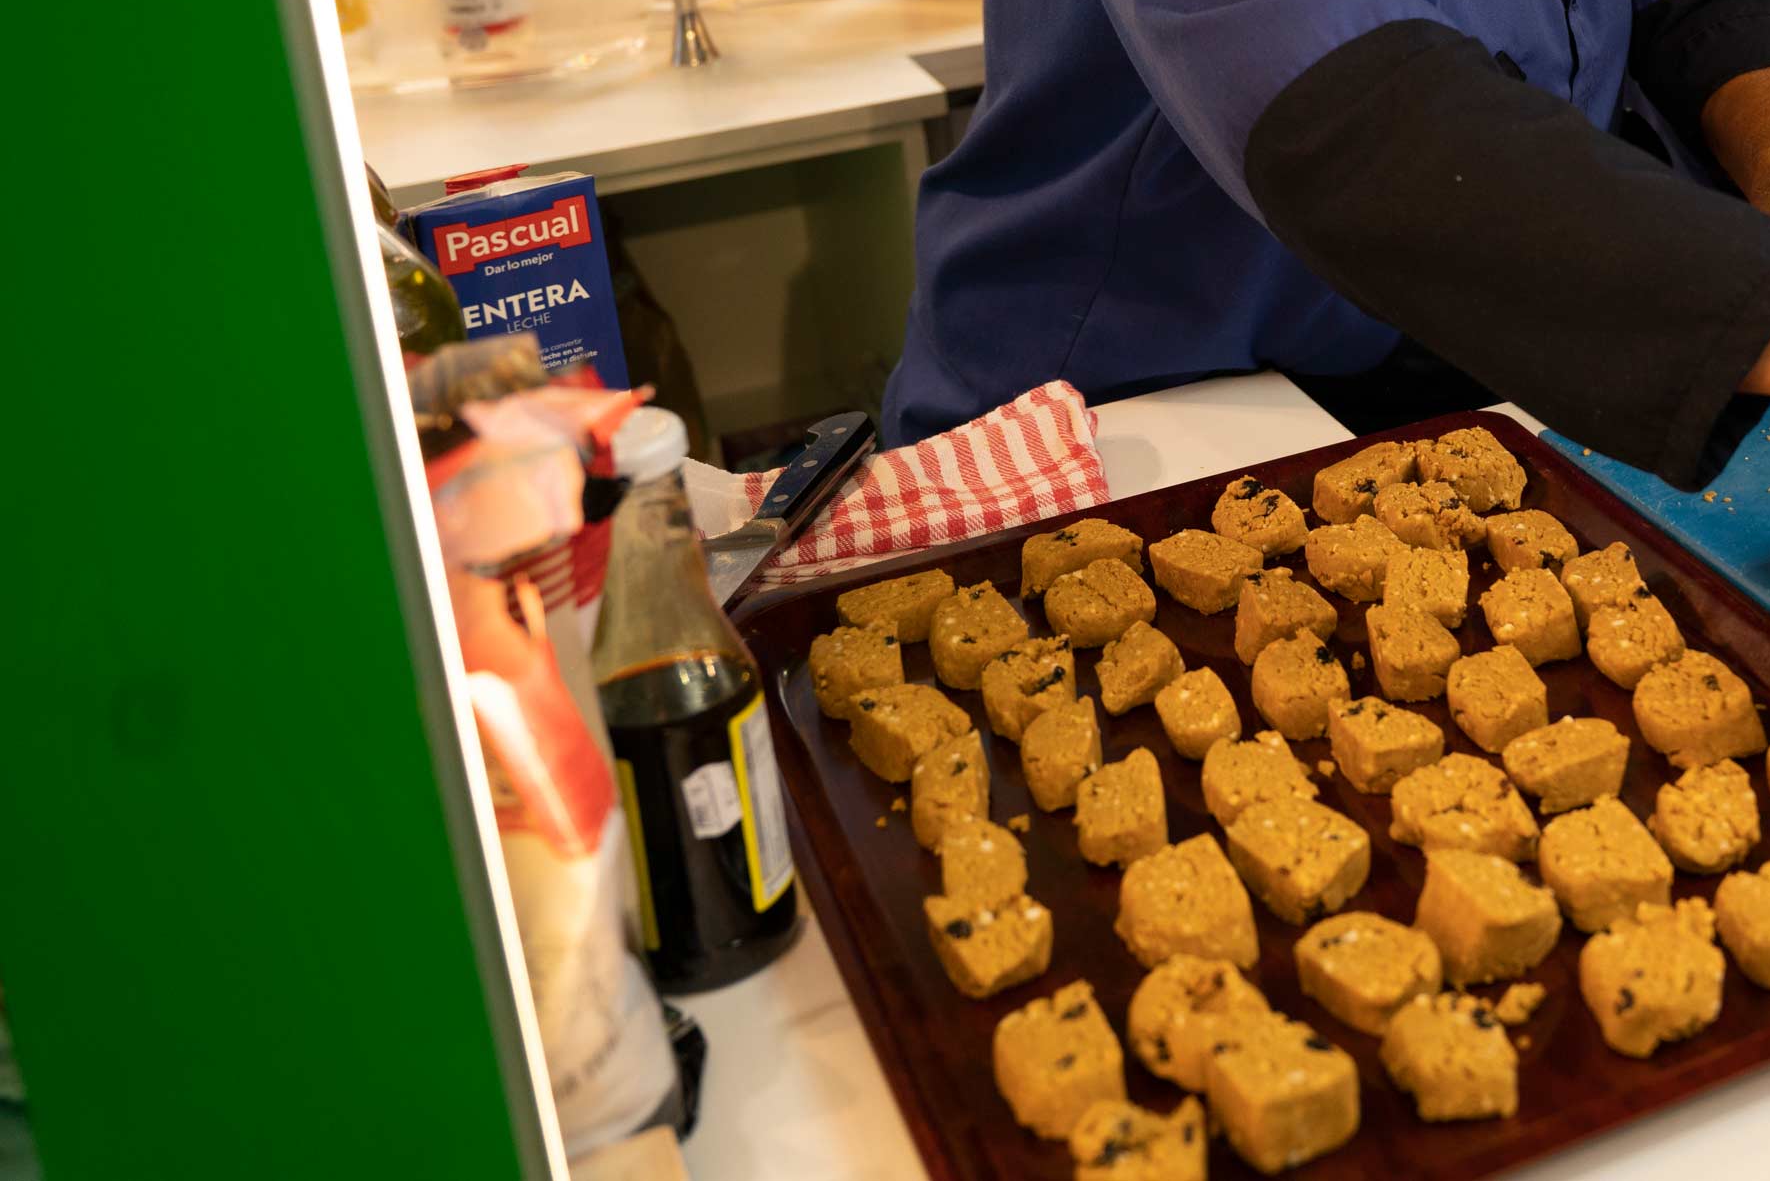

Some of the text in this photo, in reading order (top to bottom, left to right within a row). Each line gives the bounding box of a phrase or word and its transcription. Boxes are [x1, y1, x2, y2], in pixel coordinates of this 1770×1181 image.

[446, 205, 580, 262] Pascual
[484, 252, 554, 276] Dar lo mejor
[462, 278, 590, 330] ENTERA
[506, 312, 552, 334] LECHE
